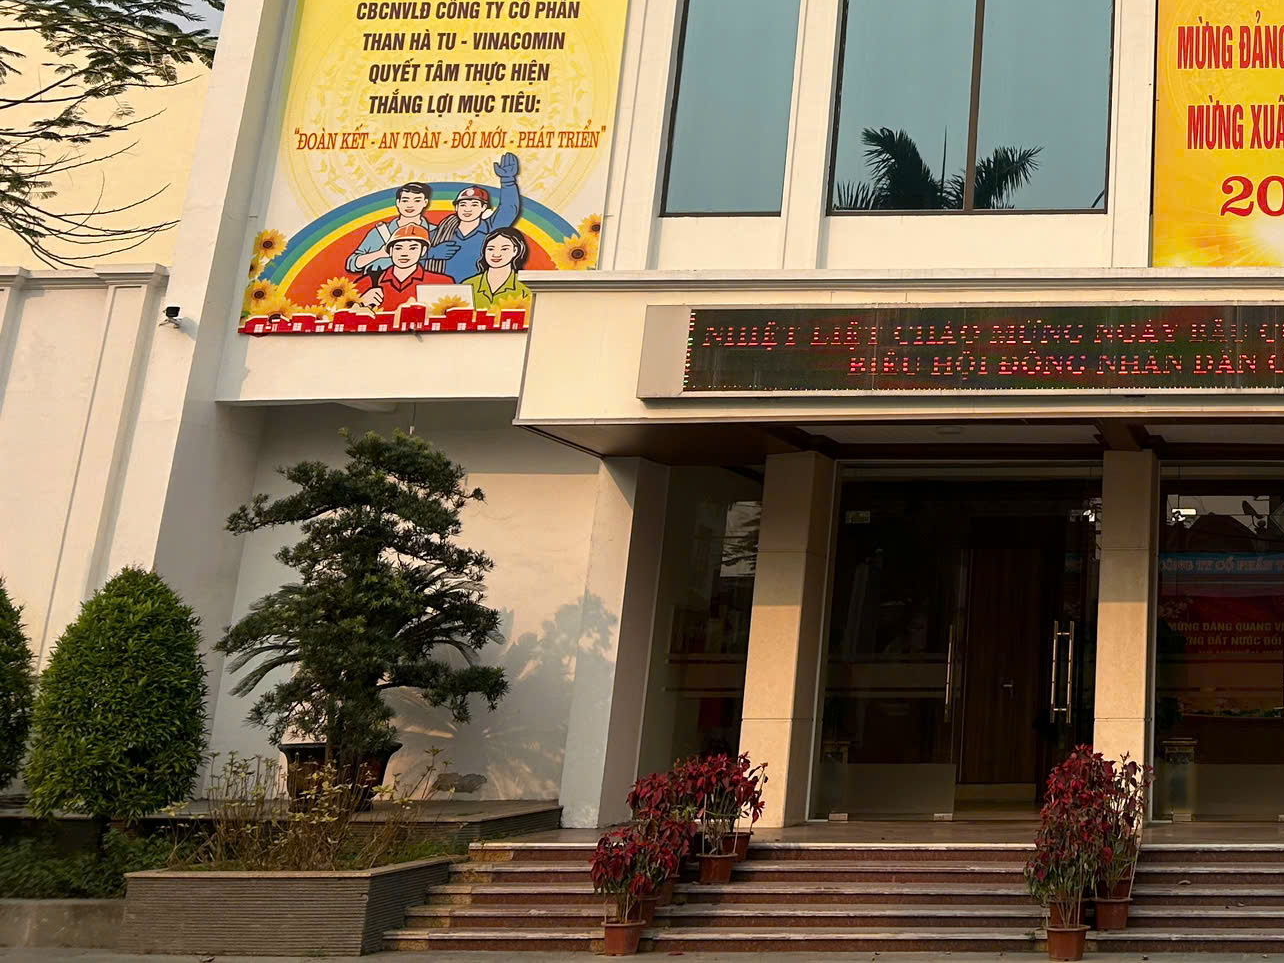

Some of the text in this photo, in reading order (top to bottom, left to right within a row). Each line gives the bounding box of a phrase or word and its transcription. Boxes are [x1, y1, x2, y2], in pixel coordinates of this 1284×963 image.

[356, 1, 431, 20] CBCNVLĐ
[485, 1, 505, 19] TY
[362, 32, 405, 51] THAN
[409, 29, 431, 51] HÀ
[436, 32, 456, 50] TU
[472, 31, 565, 50] VINACOMIN
[1177, 16, 1233, 69] MỪNG
[368, 58, 550, 85] QUYẾT TÂM THỰC HIỆN
[369, 88, 541, 117] THẮNG LỢI MỤC TIÊU:
[294, 126, 337, 150] “ĐOÀN
[339, 123, 369, 150] KẾT
[378, 132, 402, 149] AN
[402, 128, 441, 149] TOÀN
[451, 119, 481, 149] ĐỔI
[482, 125, 507, 149] MỚI
[516, 125, 557, 149] PHÁT
[556, 119, 606, 148] TRIỂN”
[1187, 94, 1244, 150] MỪNG
